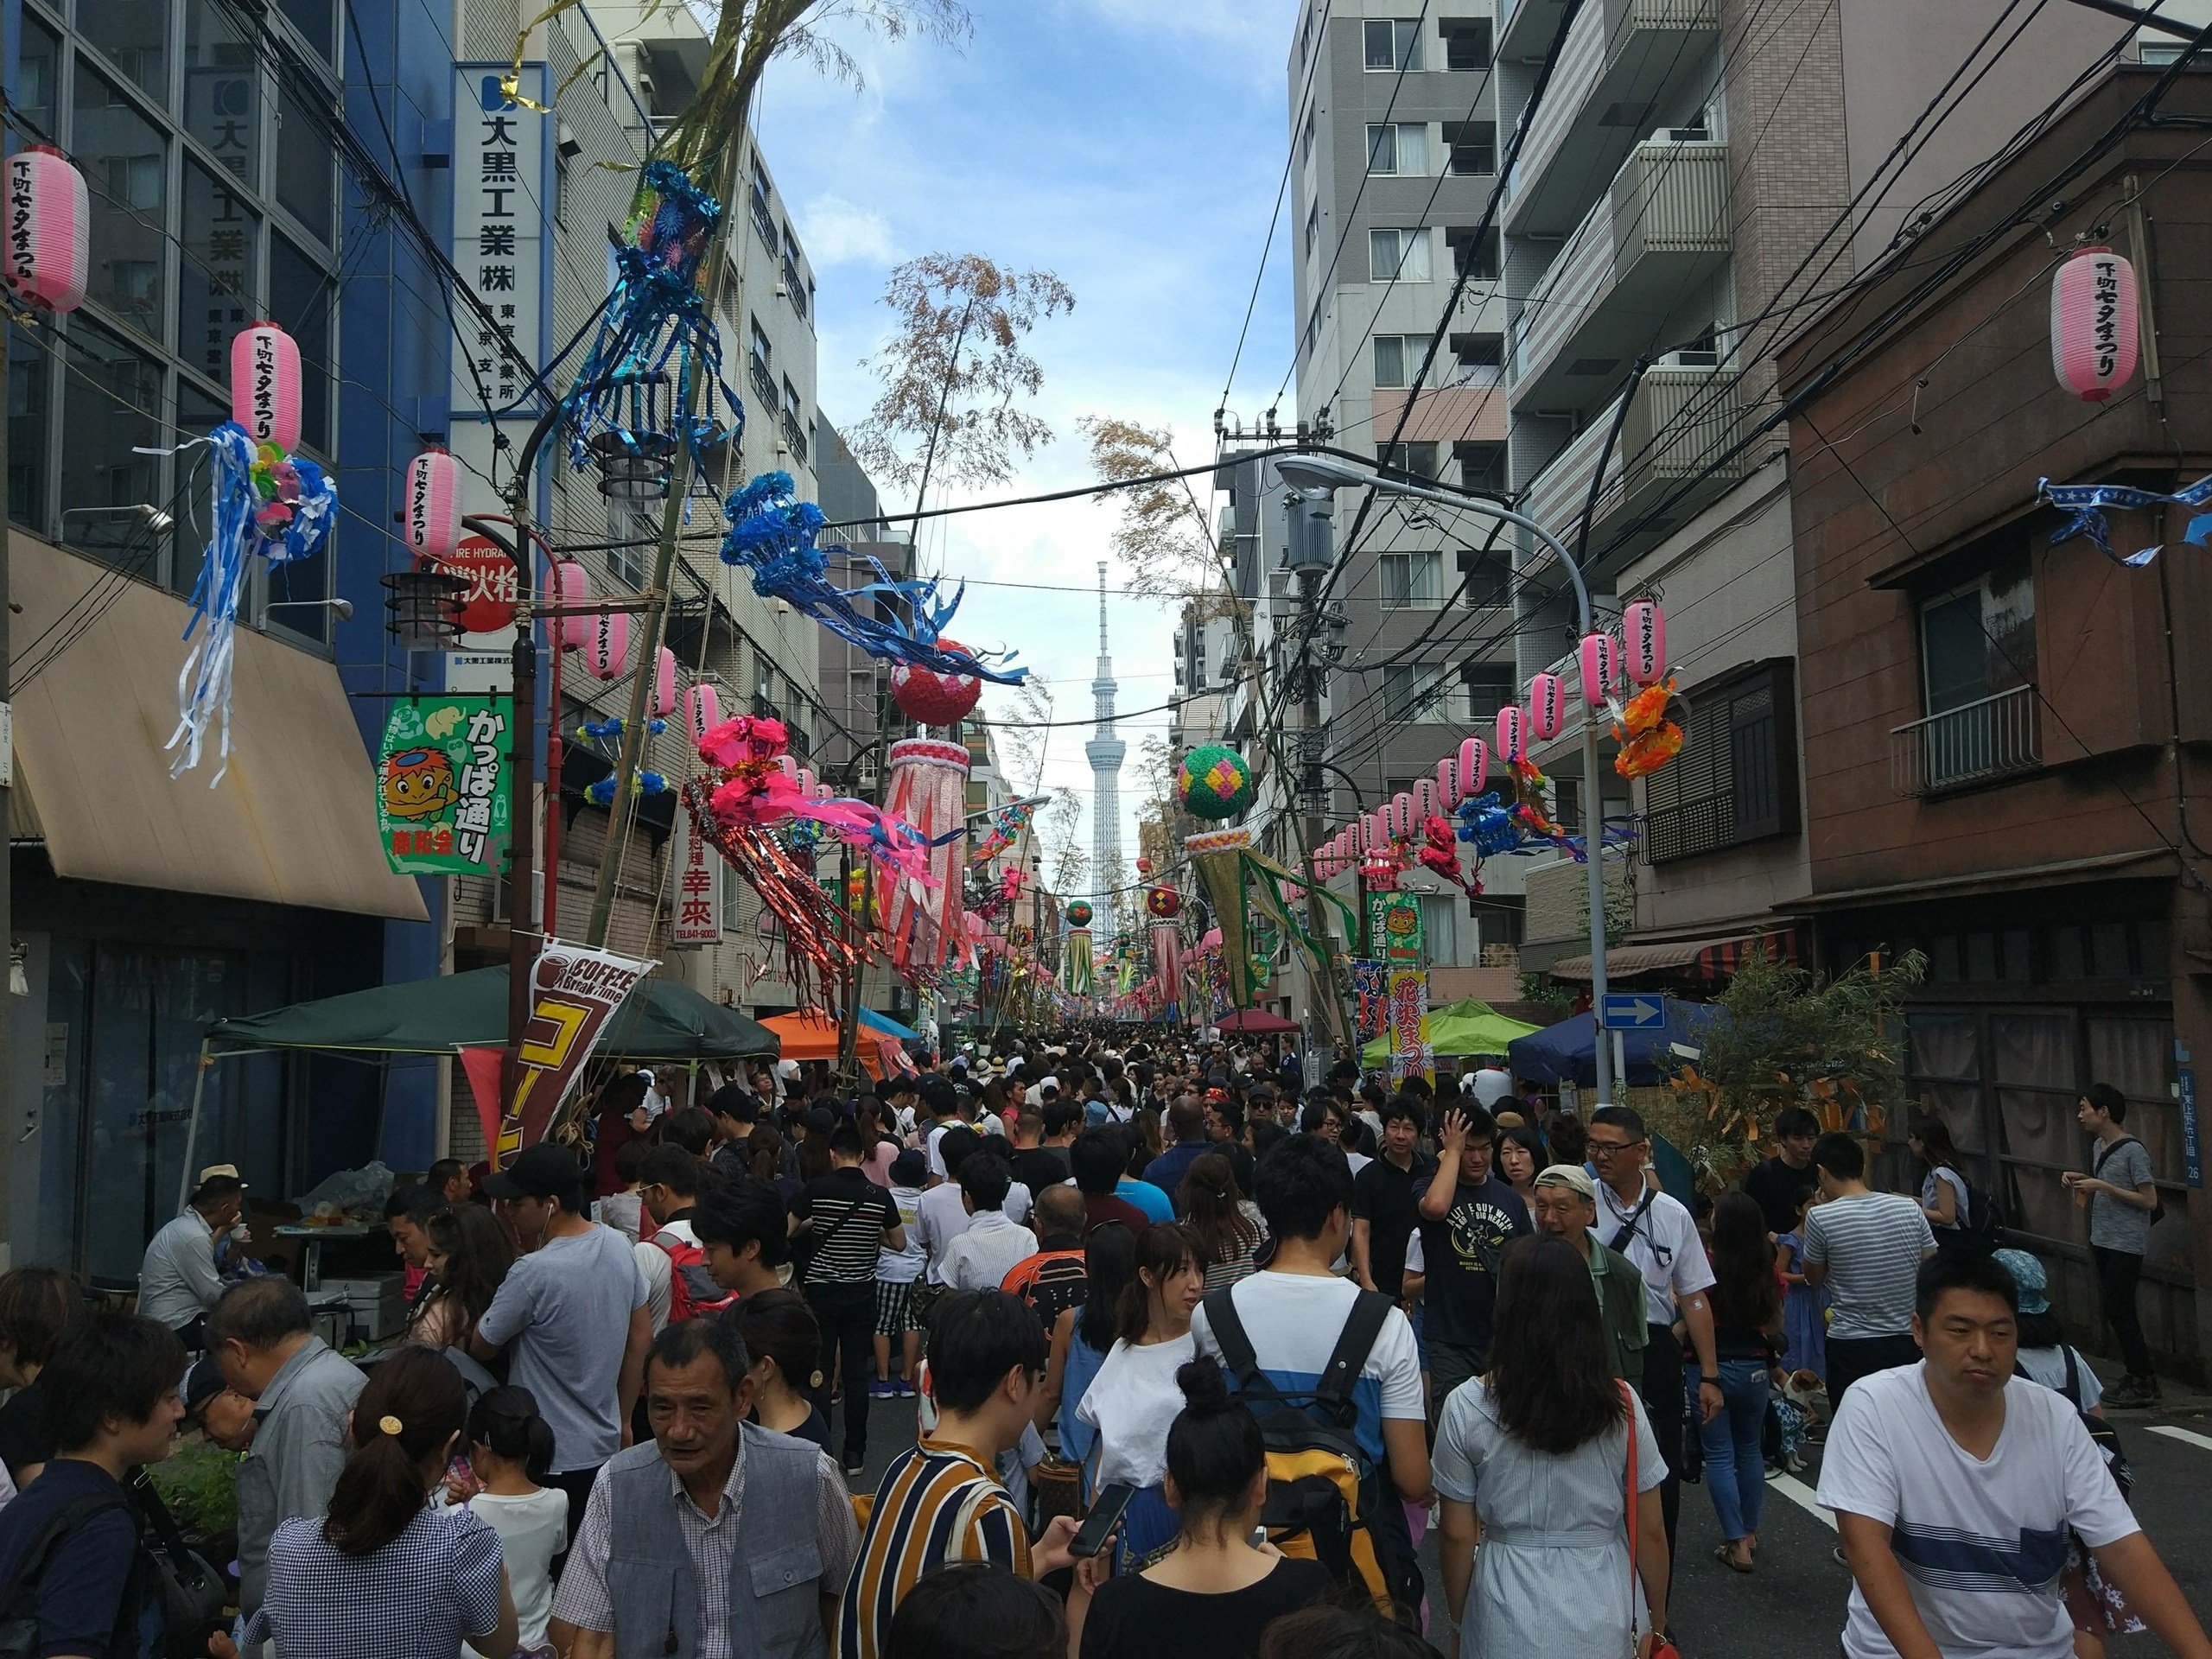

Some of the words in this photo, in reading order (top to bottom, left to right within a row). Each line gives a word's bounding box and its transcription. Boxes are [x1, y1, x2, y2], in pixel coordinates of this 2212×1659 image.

[11, 162, 35, 278] 下町七夕まつり
[2094, 263, 2118, 377] 下町七夕まつり
[254, 335, 274, 439] 下町七夕まつり
[412, 459, 429, 545] 下町七夕まつり
[474, 548, 506, 558] HYDRA
[1642, 607, 1654, 674] 下町七夕まつり
[1546, 678, 1555, 731] 下町七夕まつり
[454, 709, 505, 864] かっぱ通り
[1472, 742, 1481, 787] 下町七夕まつり
[681, 868, 712, 926] 幸來
[1371, 897, 1387, 960] かっぱ通り
[563, 975, 596, 995] Break
[594, 986, 623, 1003] Time
[570, 958, 639, 992] COFFEE
[1395, 977, 1424, 1078] 花火まつり
[2188, 1166, 2199, 1179] 26
[1446, 1217, 1456, 1227] A
[1451, 1203, 1476, 1220] LITE
[1476, 1203, 1494, 1213] GUY
[1496, 1208, 1514, 1230] WITH
